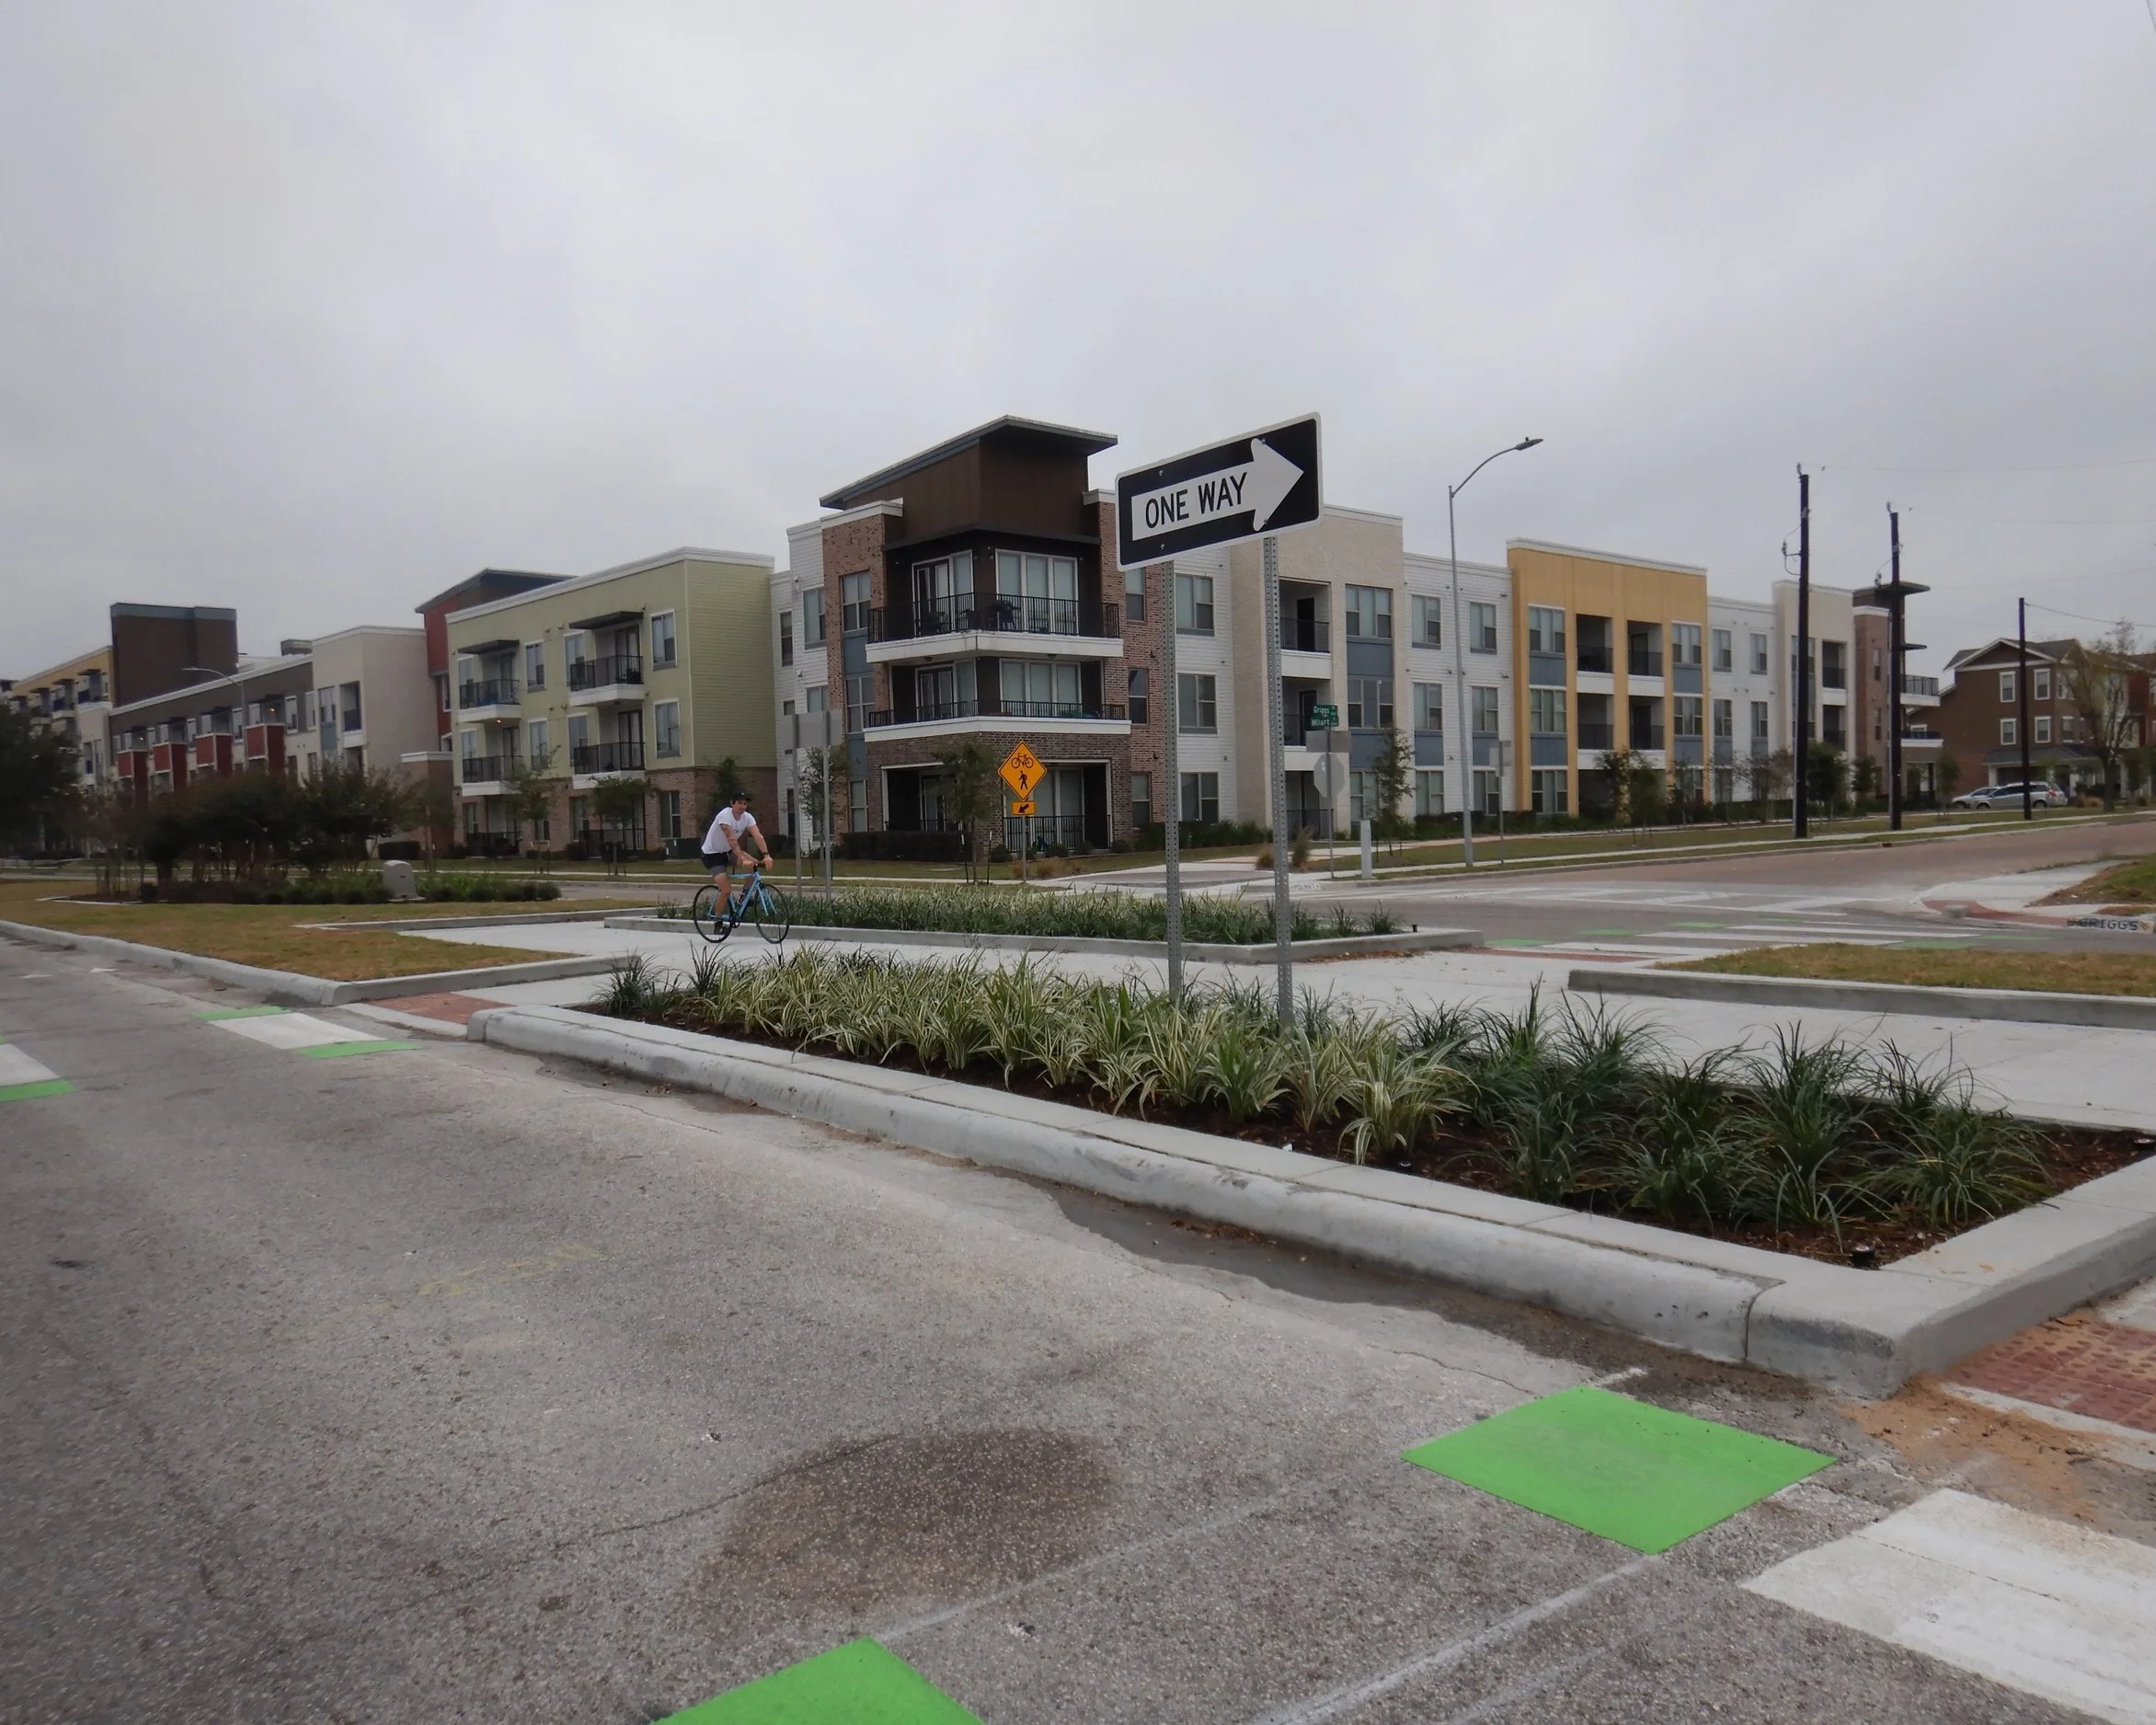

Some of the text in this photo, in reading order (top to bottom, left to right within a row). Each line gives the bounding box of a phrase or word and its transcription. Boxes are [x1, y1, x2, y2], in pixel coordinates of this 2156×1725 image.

[1145, 472, 1248, 529] ONE WAY
[1313, 706, 1330, 718] Griggs
[2078, 917, 2139, 931] GRIGGS
